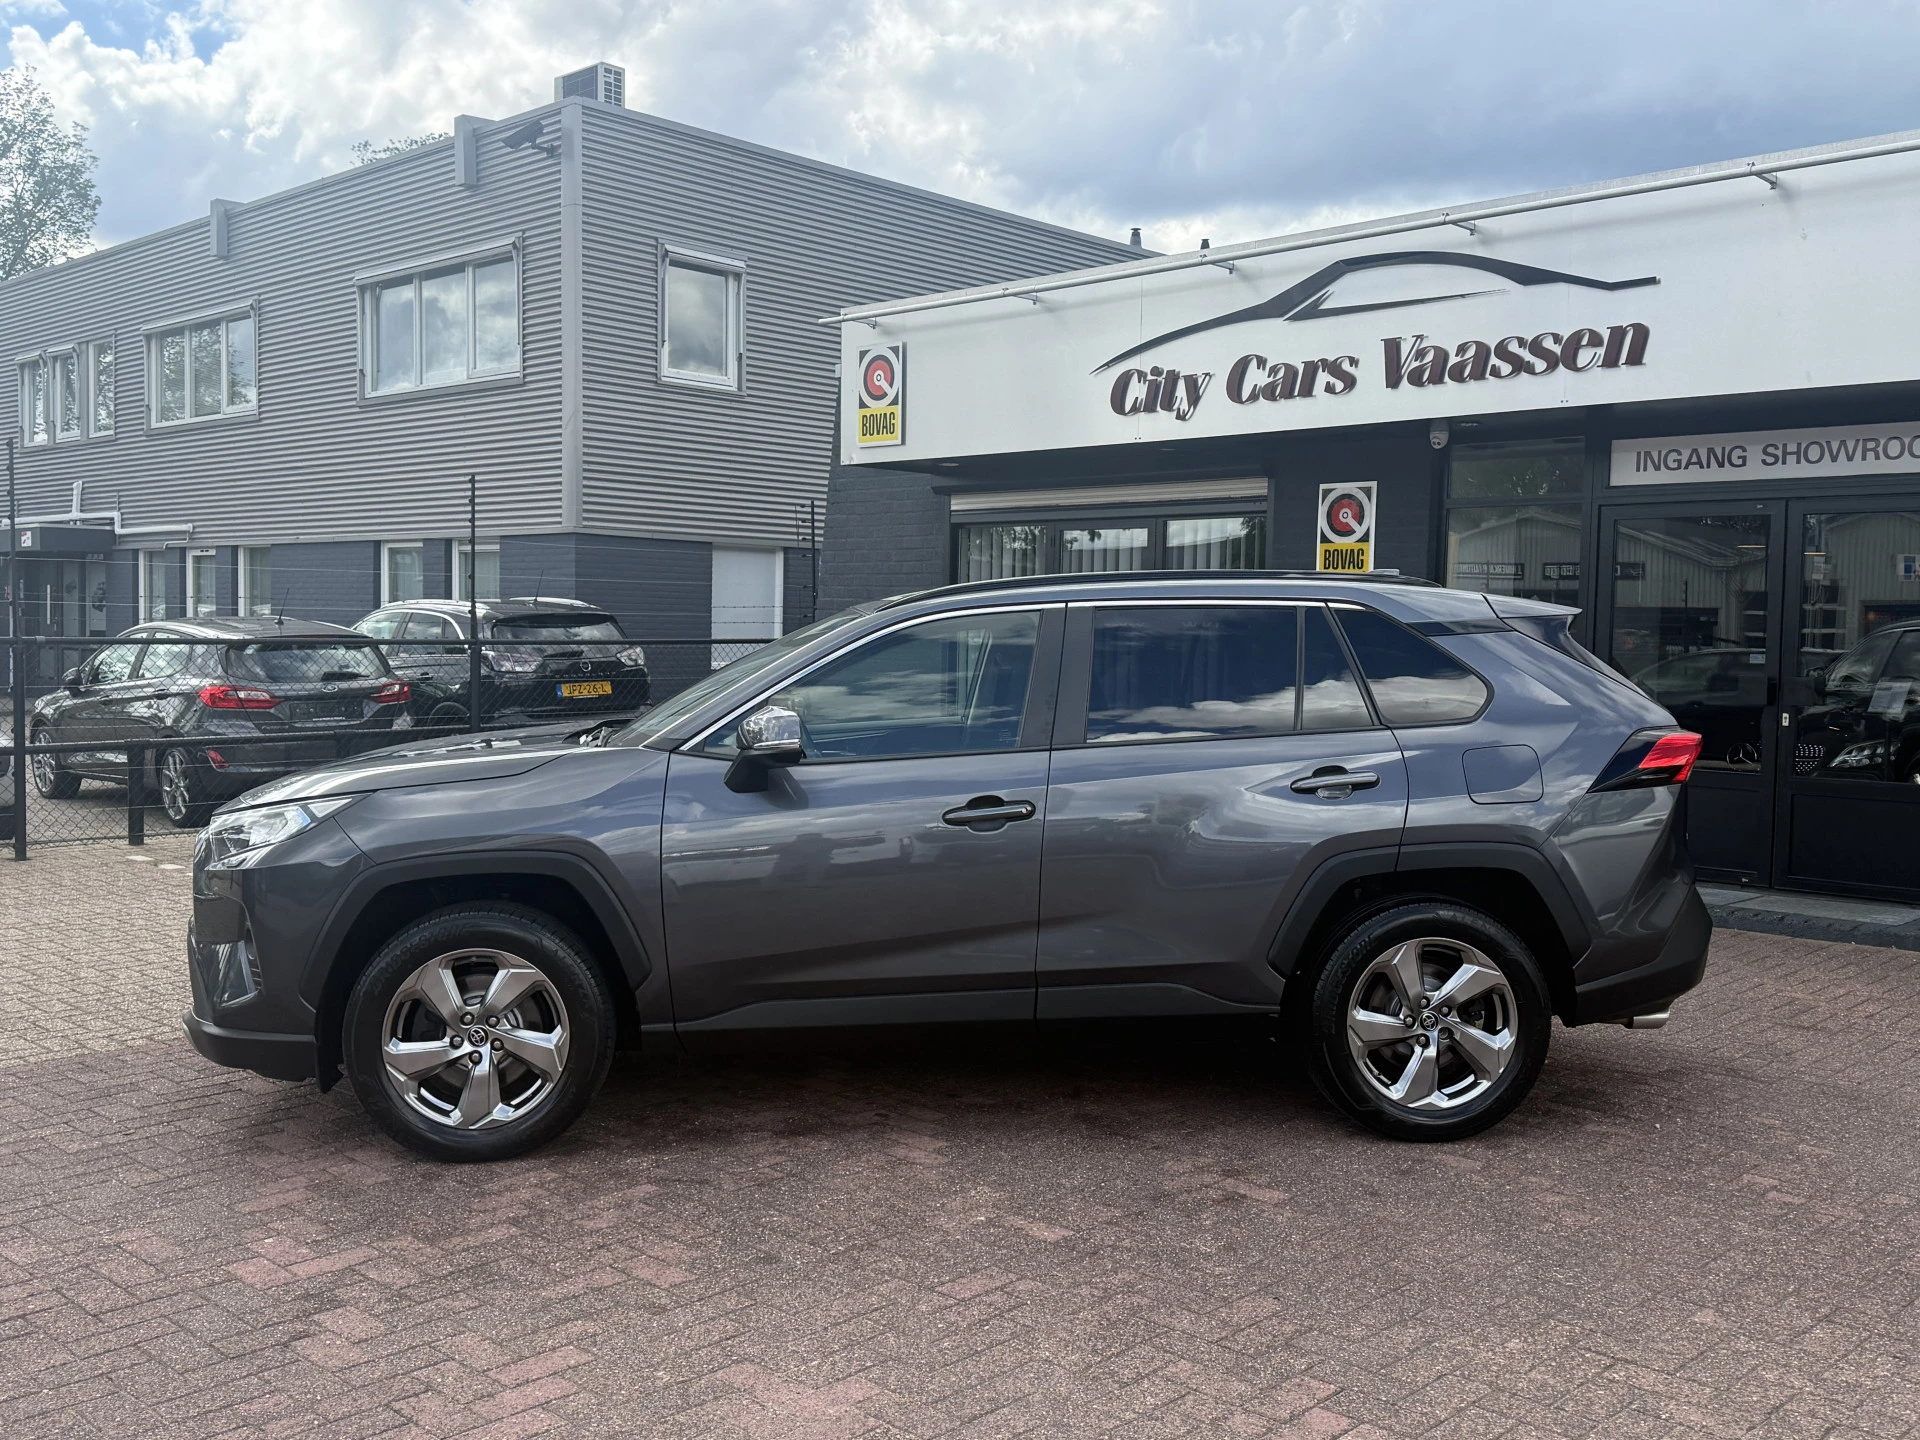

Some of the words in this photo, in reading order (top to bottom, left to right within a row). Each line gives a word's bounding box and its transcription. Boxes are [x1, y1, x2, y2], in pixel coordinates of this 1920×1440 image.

[1110, 366, 1214, 421] City
[1226, 353, 1359, 405] Cars
[1380, 322, 1650, 390] Vaassen
[861, 411, 896, 437] BOVAG
[1635, 445, 1748, 473] INGANG
[1323, 548, 1365, 570] BOVAG
